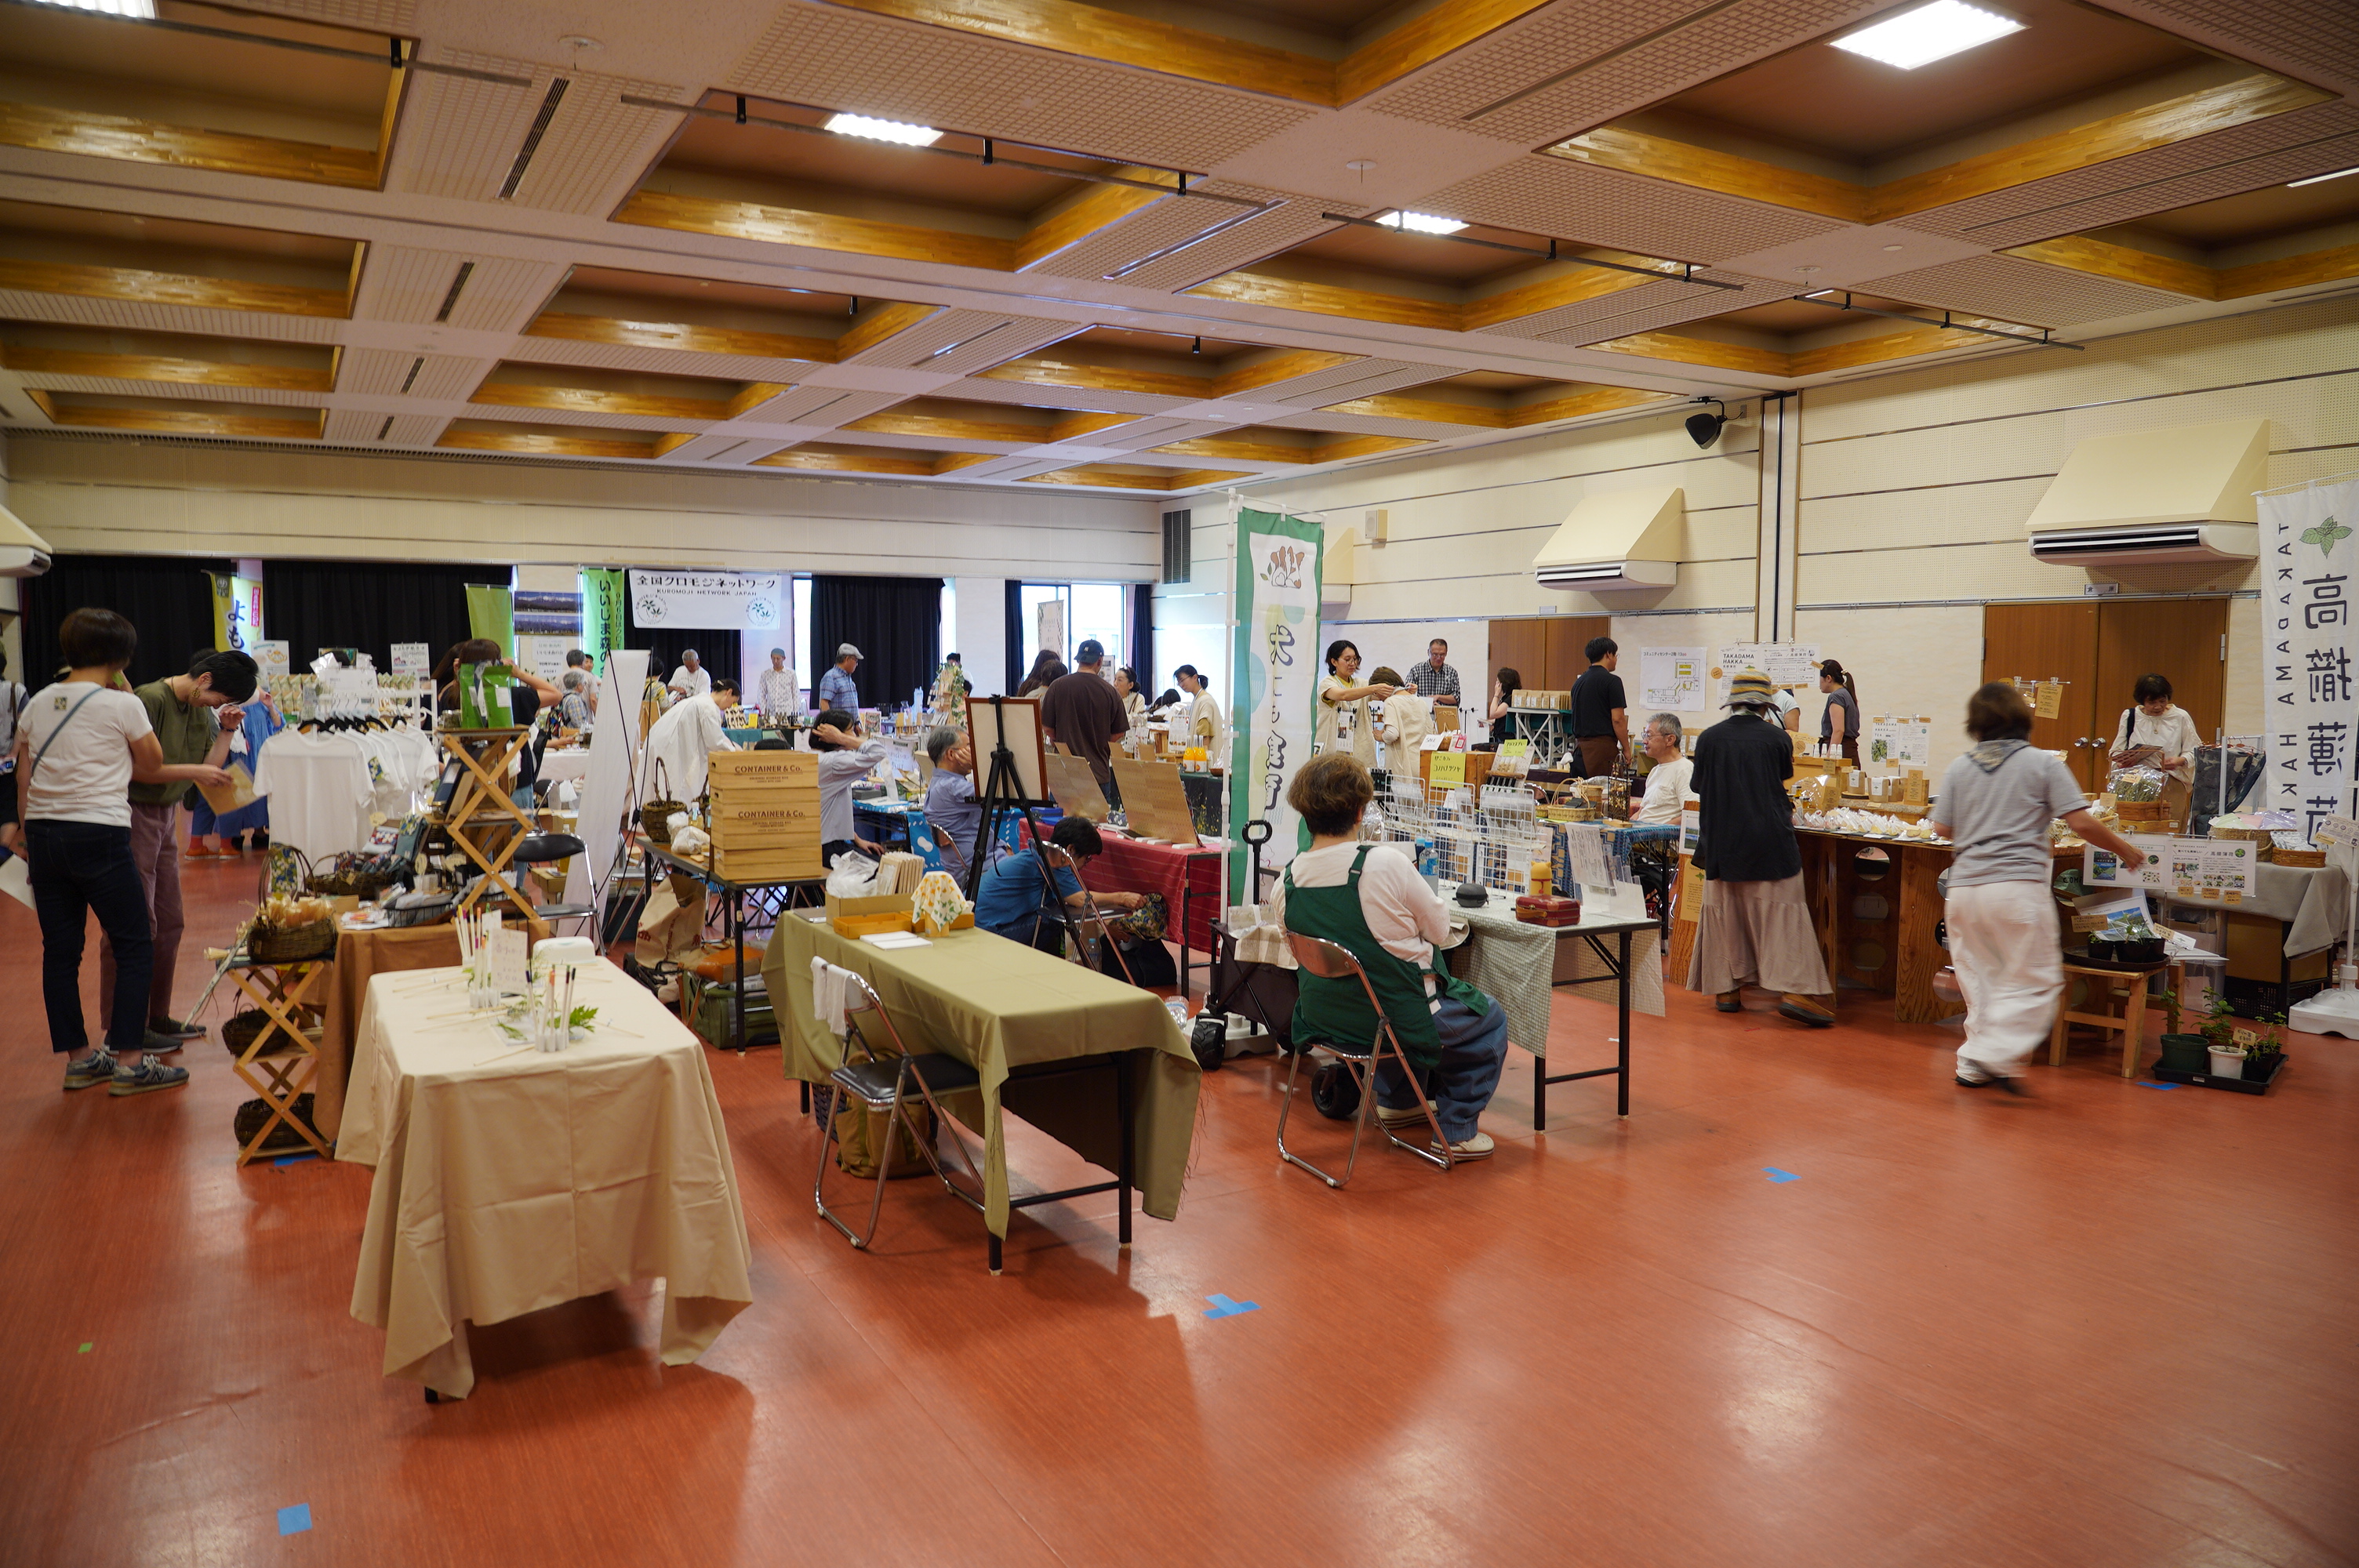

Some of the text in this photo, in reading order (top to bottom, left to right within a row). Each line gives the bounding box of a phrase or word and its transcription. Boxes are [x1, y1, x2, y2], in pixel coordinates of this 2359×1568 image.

[637, 575, 776, 589] 全国クロモジネットワーク
[735, 765, 781, 774] CONTAINER
[738, 810, 784, 819] CONTAINER
